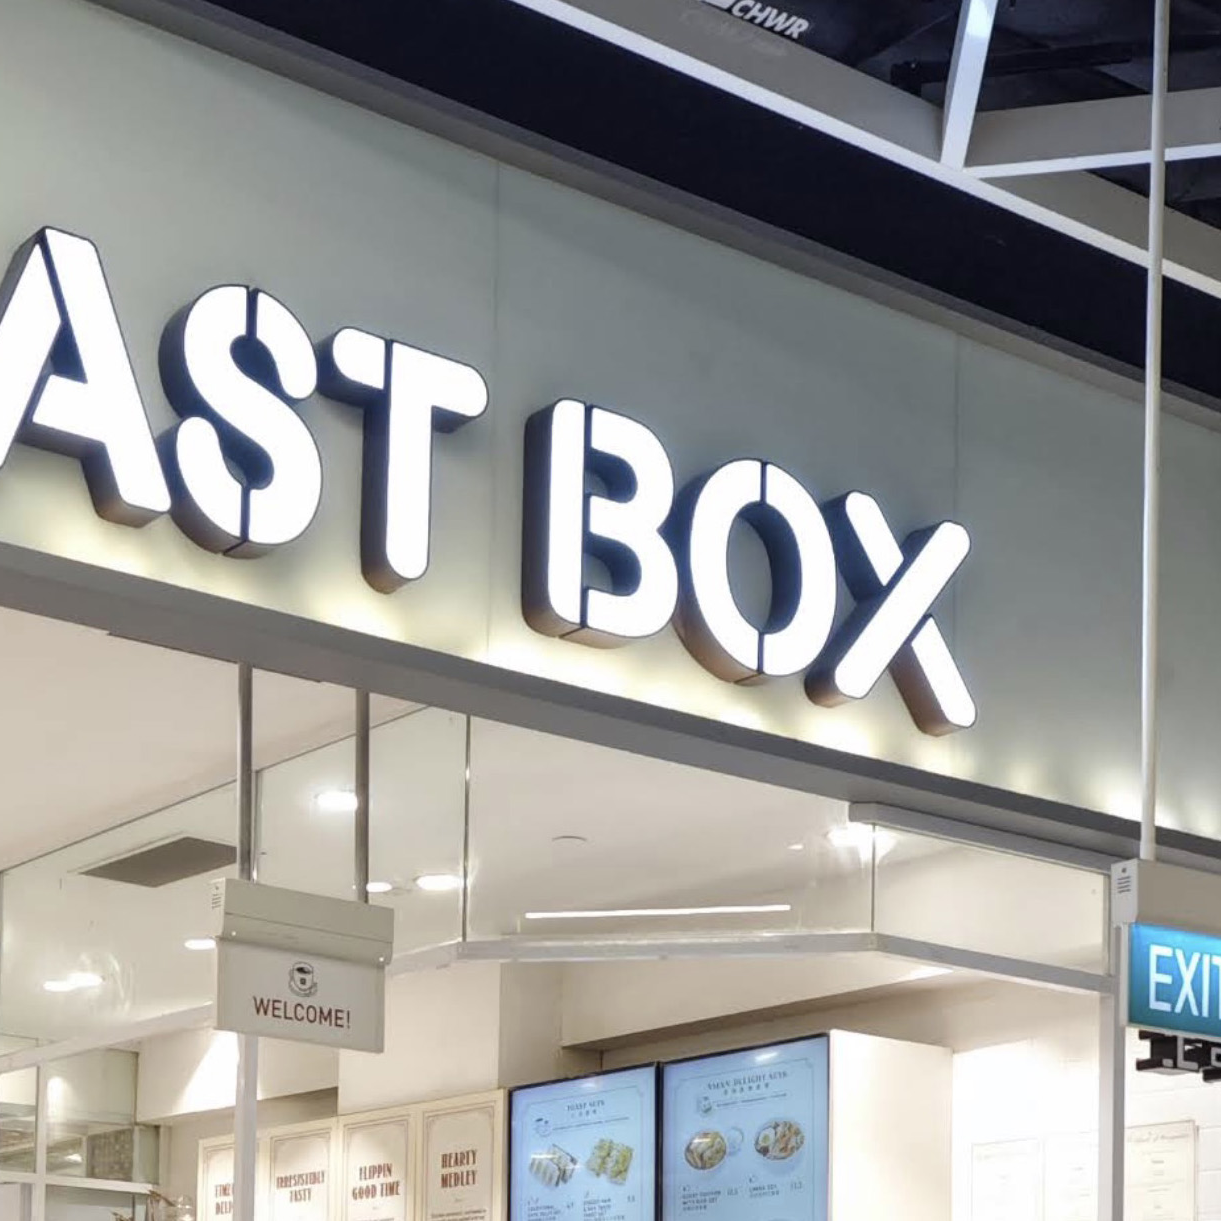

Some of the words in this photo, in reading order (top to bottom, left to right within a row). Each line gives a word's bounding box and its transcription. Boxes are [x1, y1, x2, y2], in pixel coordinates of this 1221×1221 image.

[525, 398, 977, 735] BOX
[253, 995, 352, 1029] WELCOME!
[441, 1149, 477, 1169] HEARTY
[441, 1169, 477, 1189] MEDLEY
[290, 1188, 311, 1203] TASTY
[352, 1183, 377, 1200] GOOD
[380, 1180, 401, 1198] TIME
[215, 1201, 233, 1215] DELI
